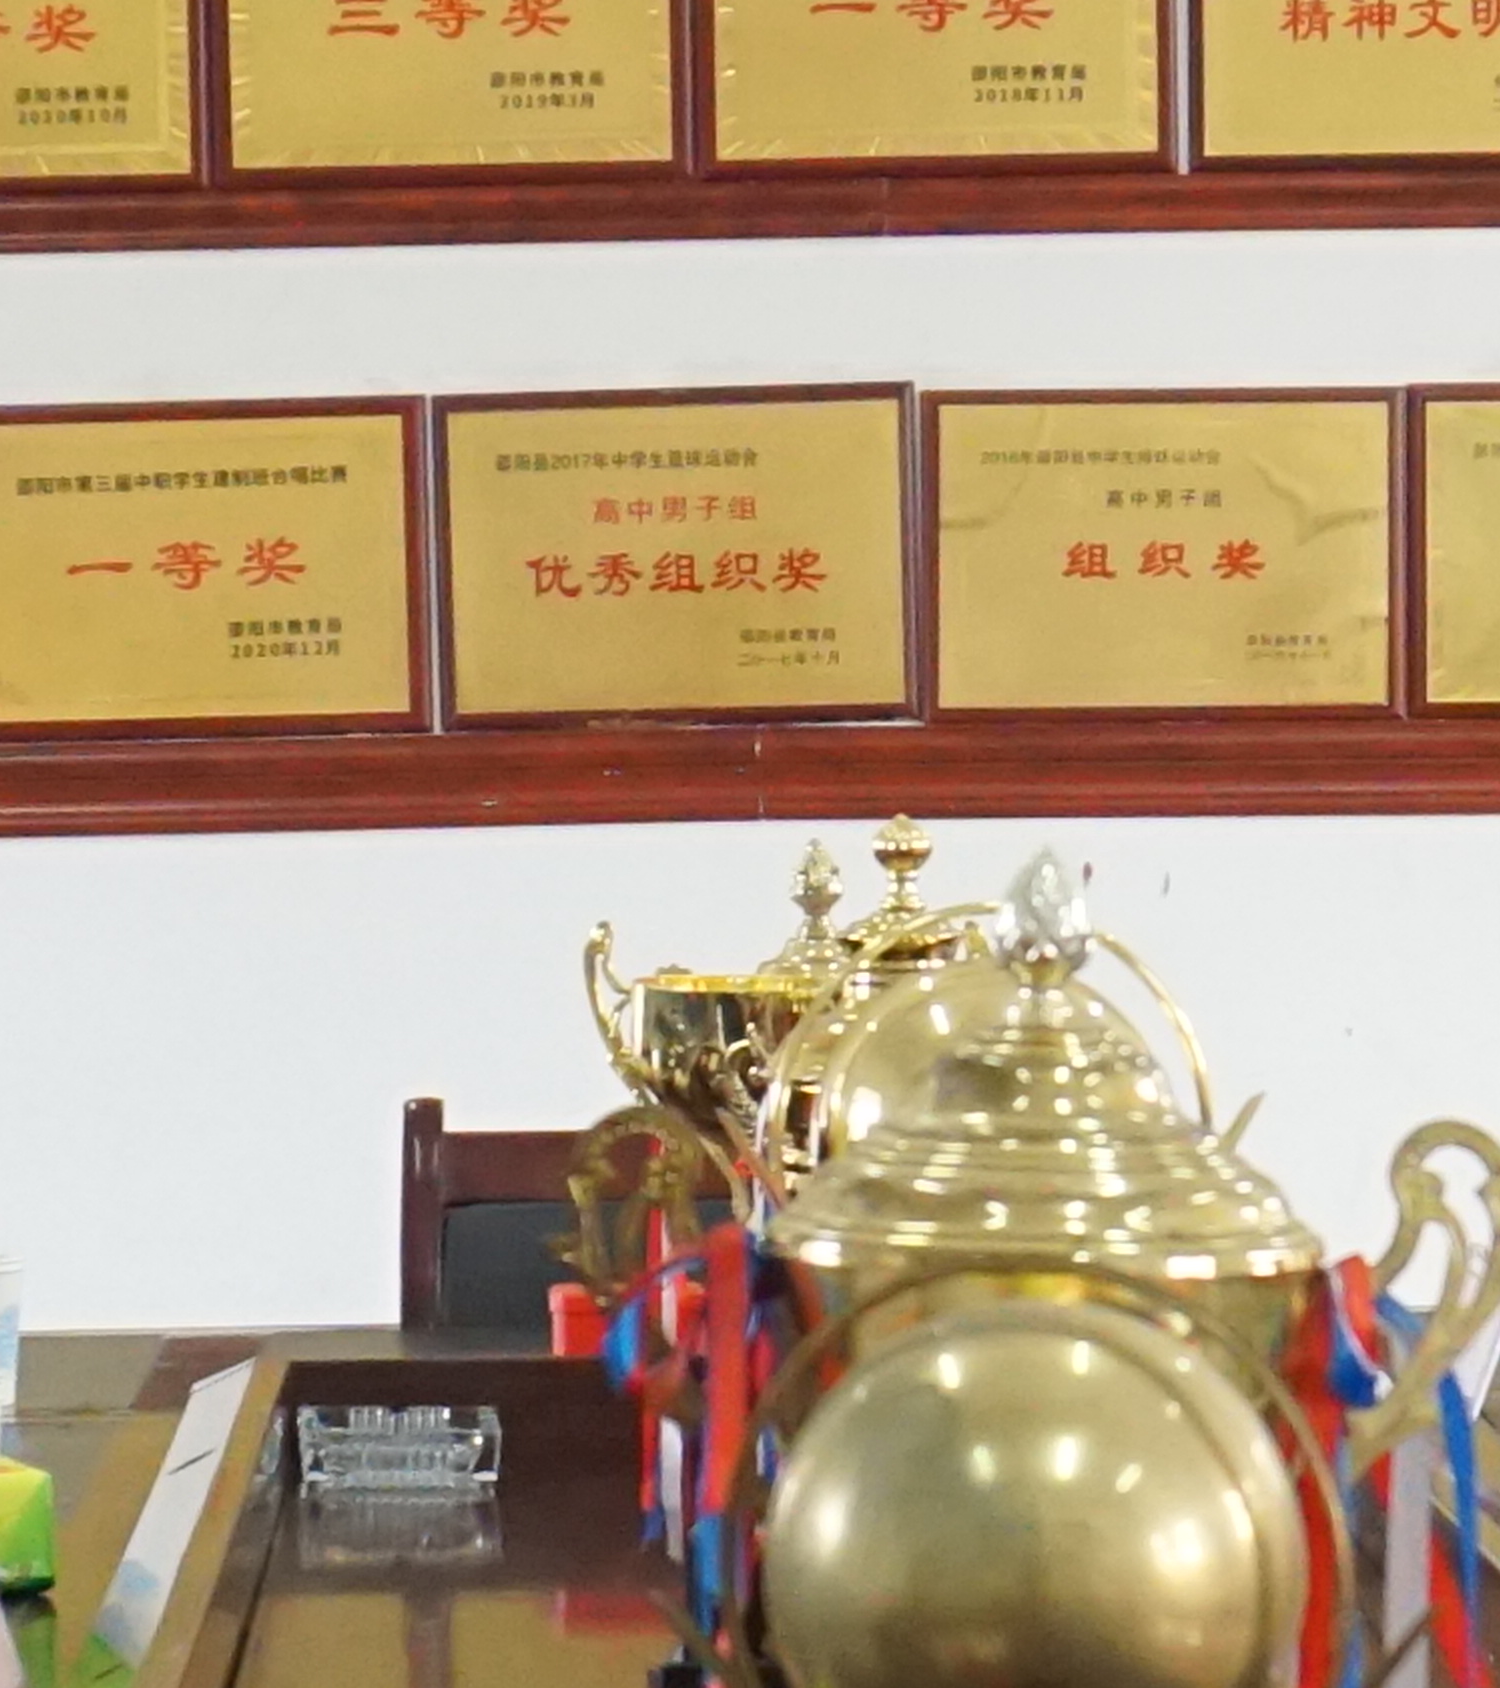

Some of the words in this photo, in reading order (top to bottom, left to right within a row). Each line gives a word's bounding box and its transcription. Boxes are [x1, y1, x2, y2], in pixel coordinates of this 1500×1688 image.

[327, 0, 571, 40] 三等奖
[810, 0, 1054, 33] 一等奖
[593, 495, 757, 524] 高中男子组
[66, 536, 307, 591] 一等奖
[525, 548, 827, 598] 优秀组织奖
[1062, 539, 1265, 580] 组织奖
[231, 638, 340, 659] 2020年12月
